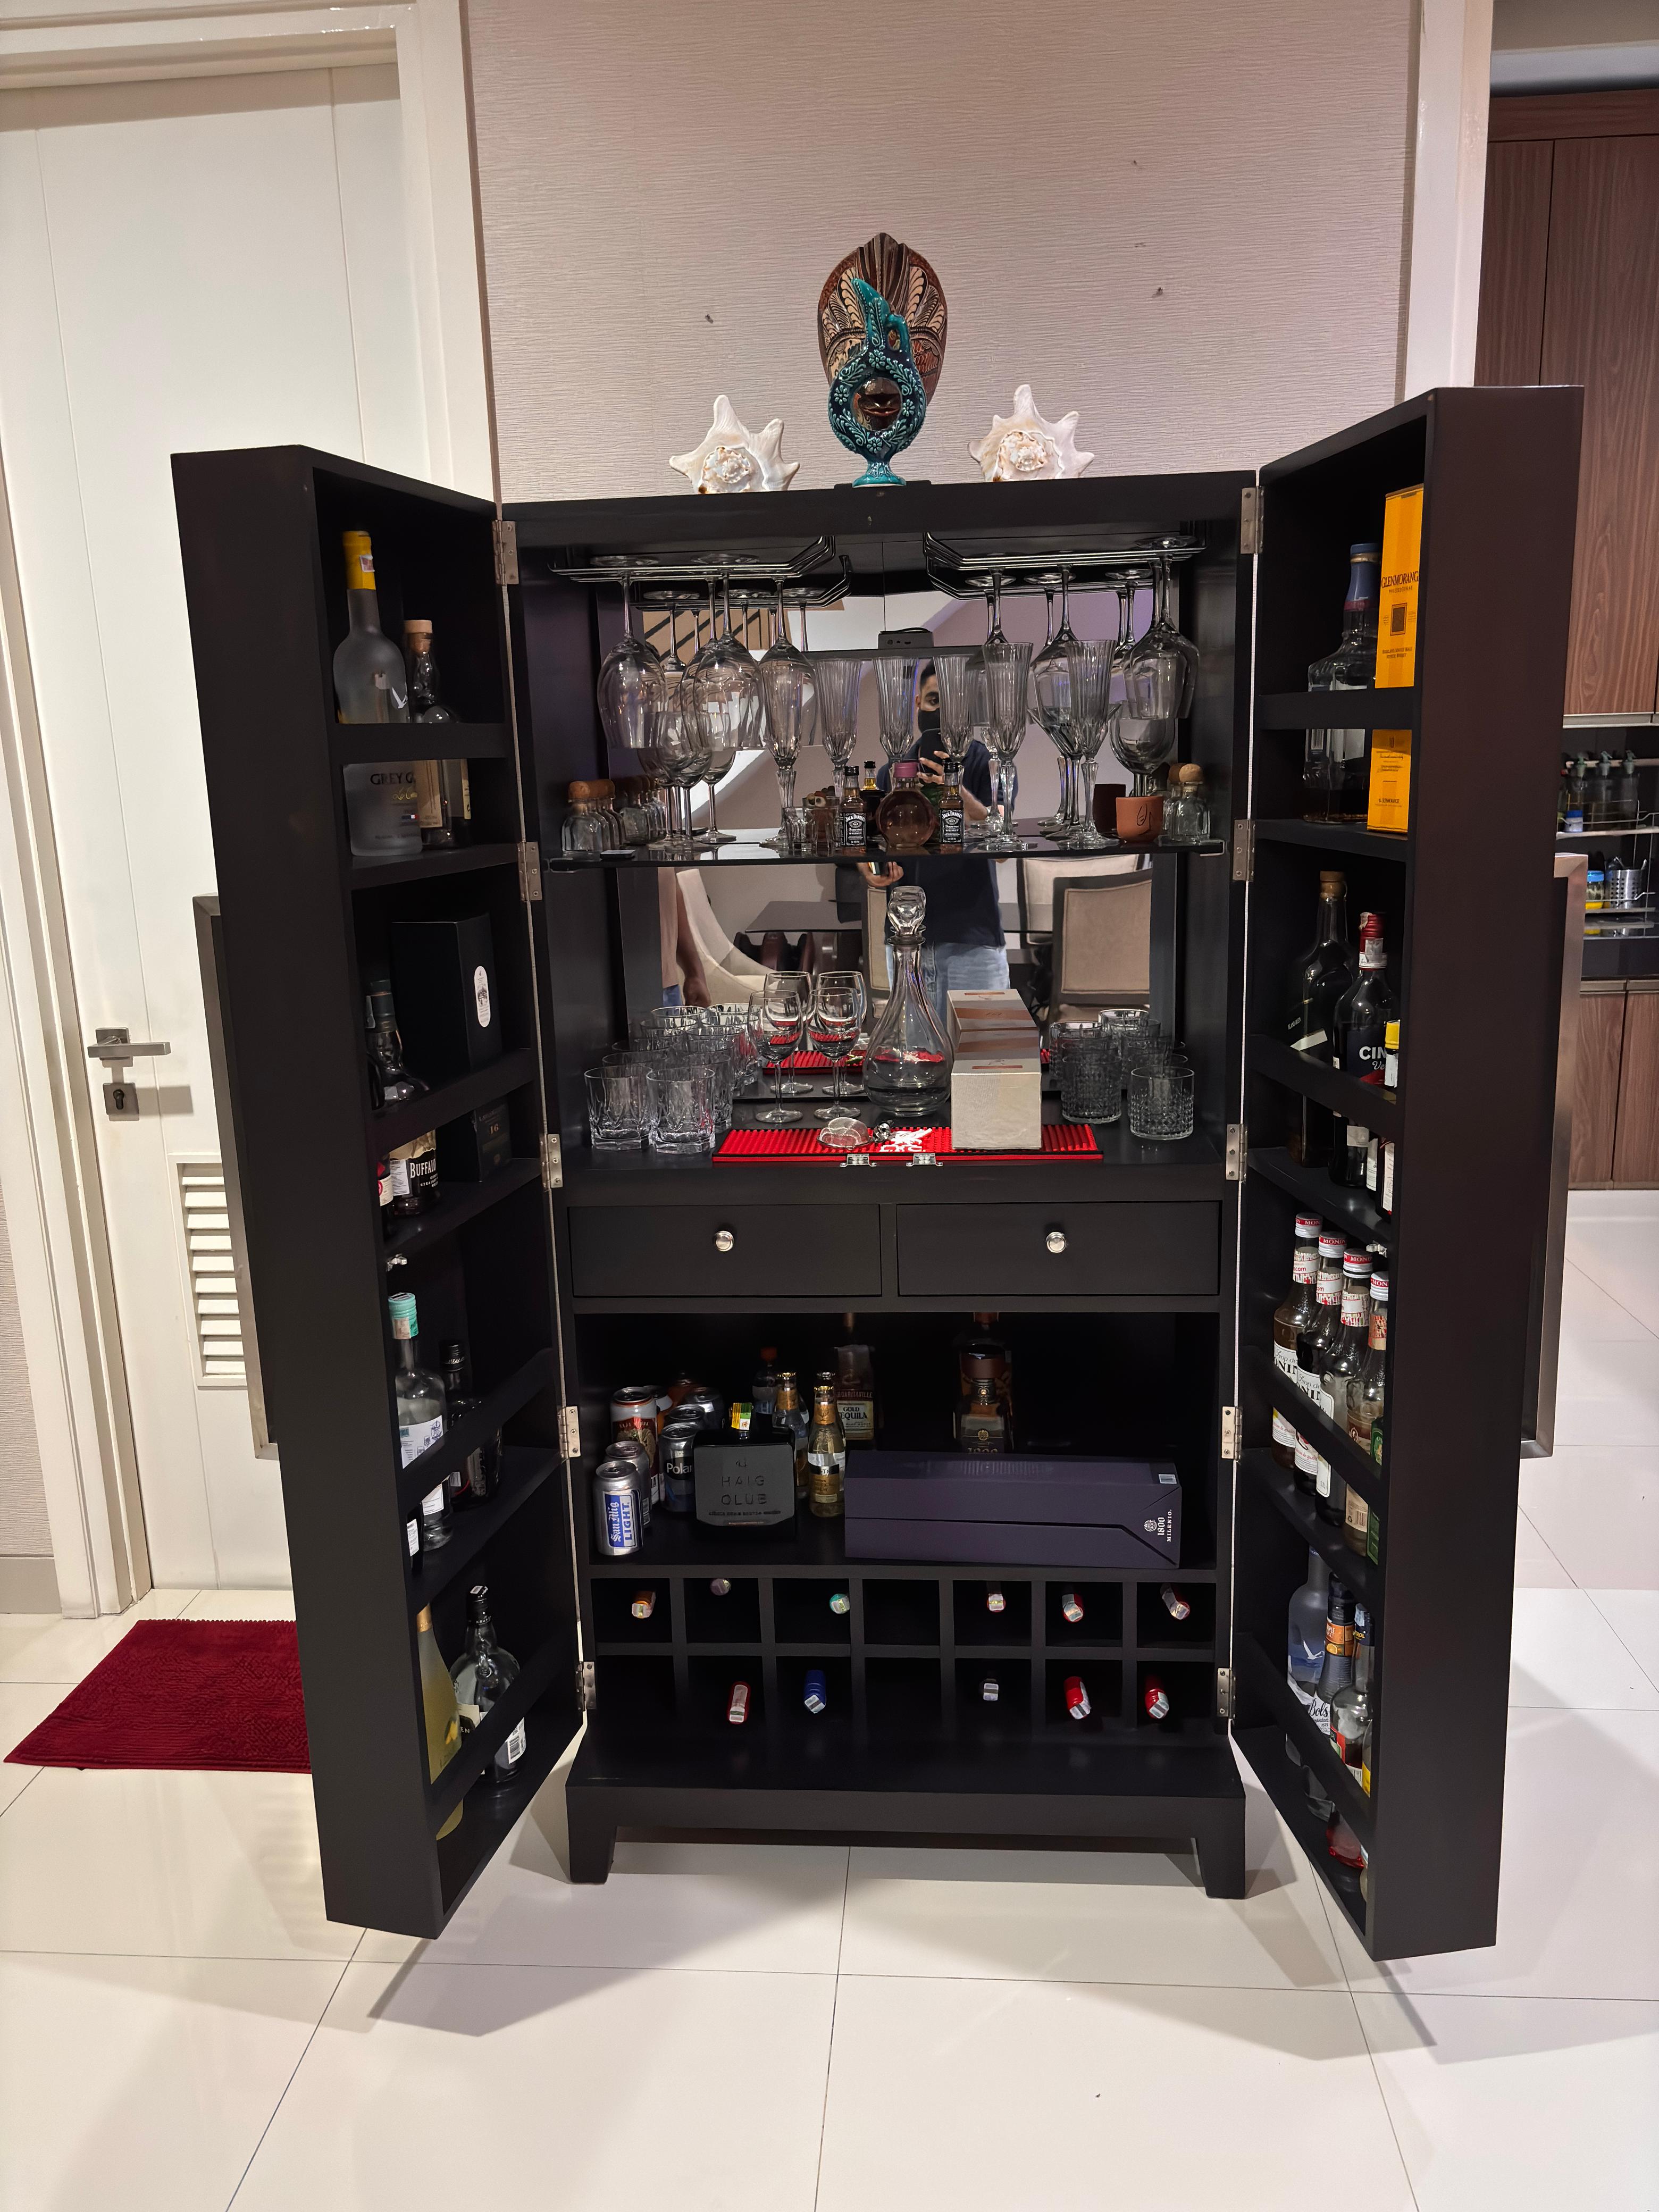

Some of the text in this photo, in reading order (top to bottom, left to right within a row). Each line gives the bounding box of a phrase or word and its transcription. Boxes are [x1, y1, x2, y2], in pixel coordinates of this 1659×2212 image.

[370, 773, 403, 785] GREY
[409, 1158, 437, 1178] BUFFALO
[722, 1475, 764, 1487] HAIG
[622, 1503, 633, 1540] LIGHT
[1157, 1516, 1166, 1536] 1800
[1309, 1697, 1328, 1717] Bols
